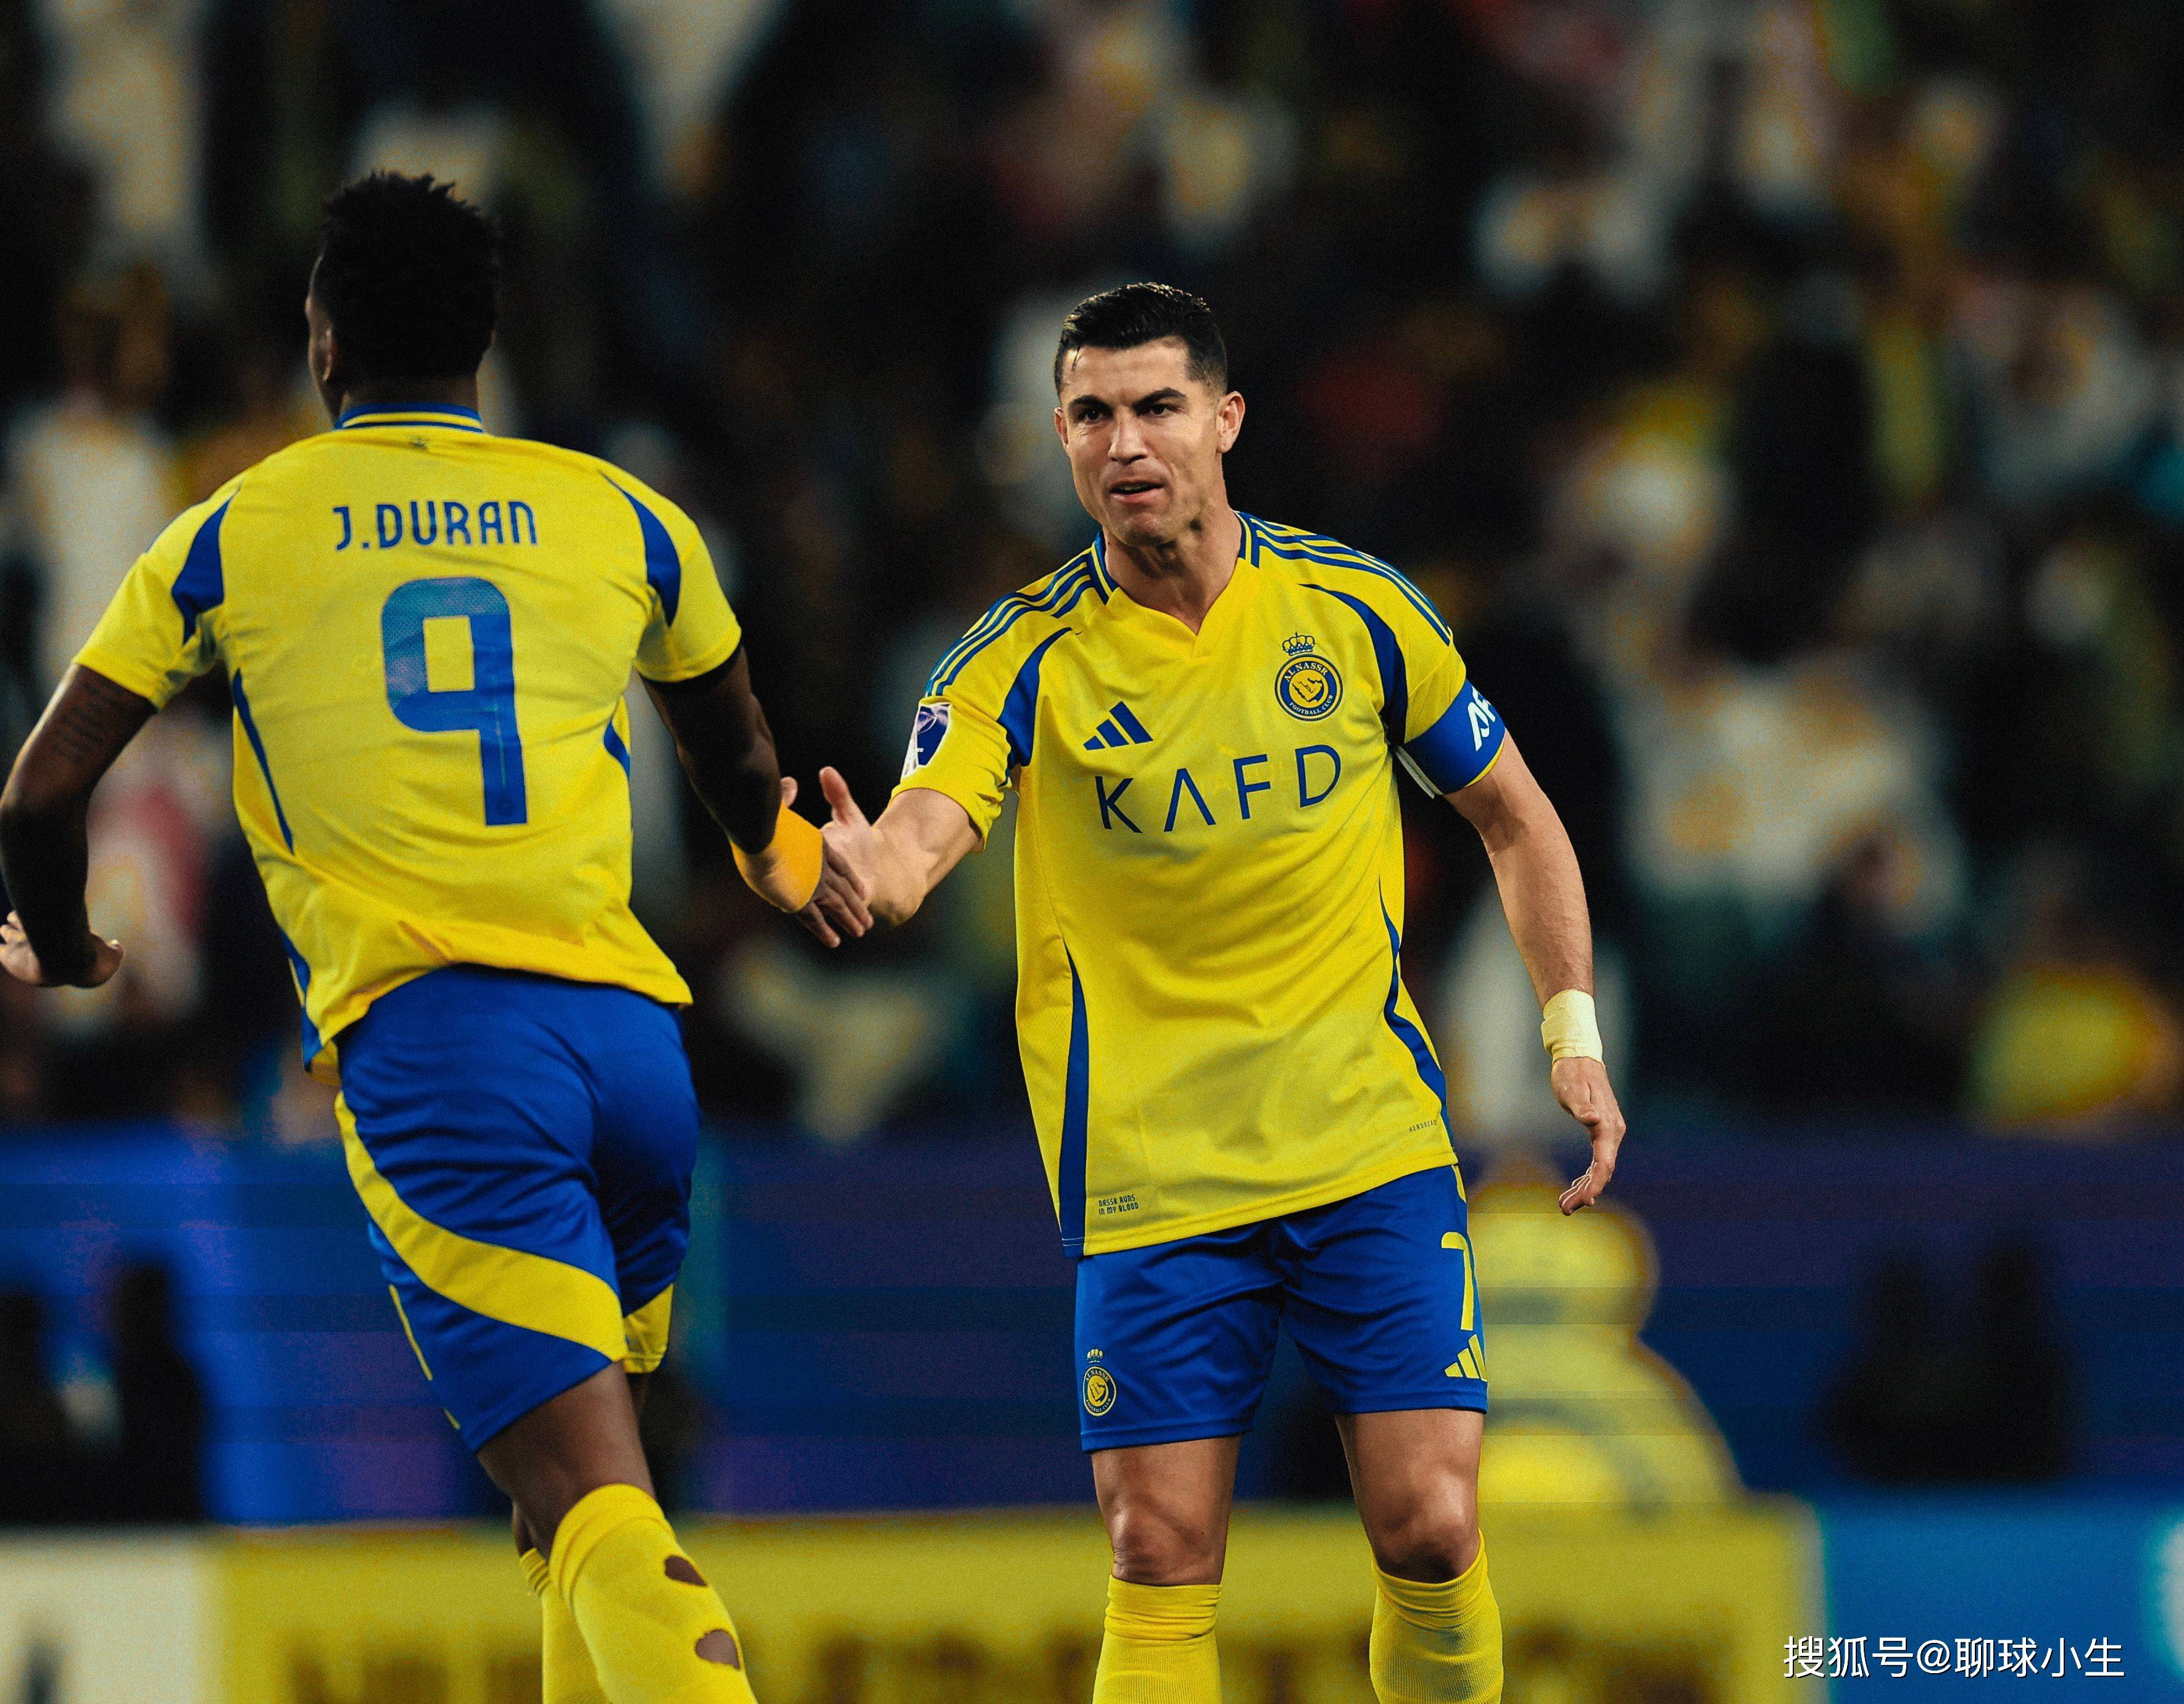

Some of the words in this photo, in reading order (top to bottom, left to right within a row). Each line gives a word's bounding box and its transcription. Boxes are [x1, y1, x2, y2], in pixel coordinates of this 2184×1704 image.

[331, 501, 539, 551] J.DURAN
[1284, 669, 1296, 682] AL
[1295, 662, 1328, 676] NASSR
[381, 576, 528, 826] 9
[1290, 702, 1322, 715] FOOTBALL
[1322, 695, 1334, 710] CLUB
[1095, 744, 1341, 834] KAFD
[1098, 1198, 1118, 1207] NASSR
[1119, 1194, 1136, 1203] RUNS
[1107, 1206, 1116, 1214] MY
[1118, 1202, 1139, 1212] BLOOD
[1441, 1231, 1474, 1331] 7
